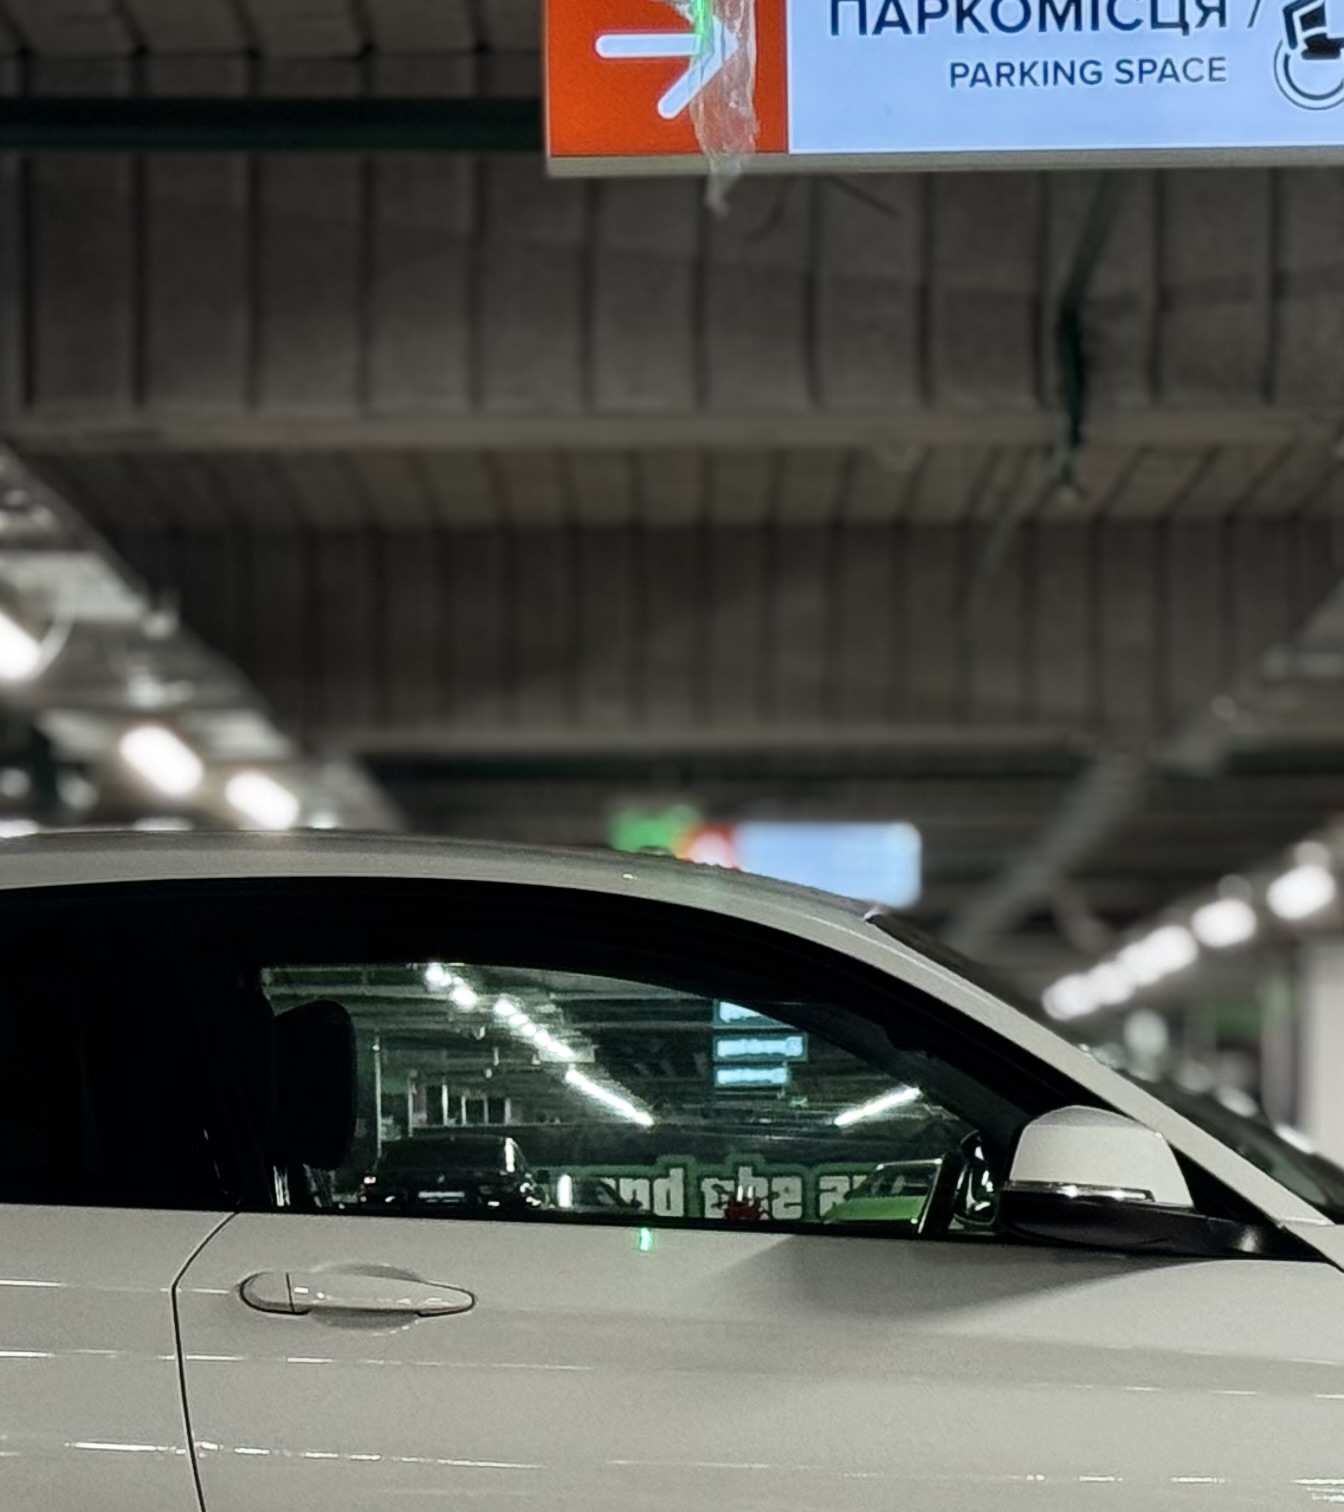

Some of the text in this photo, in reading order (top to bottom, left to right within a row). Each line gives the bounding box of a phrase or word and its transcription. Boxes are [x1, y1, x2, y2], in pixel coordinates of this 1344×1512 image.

[829, 0, 1228, 37] ПАРКОМІСЦЯ
[949, 56, 1228, 88] PARKING SPACE
